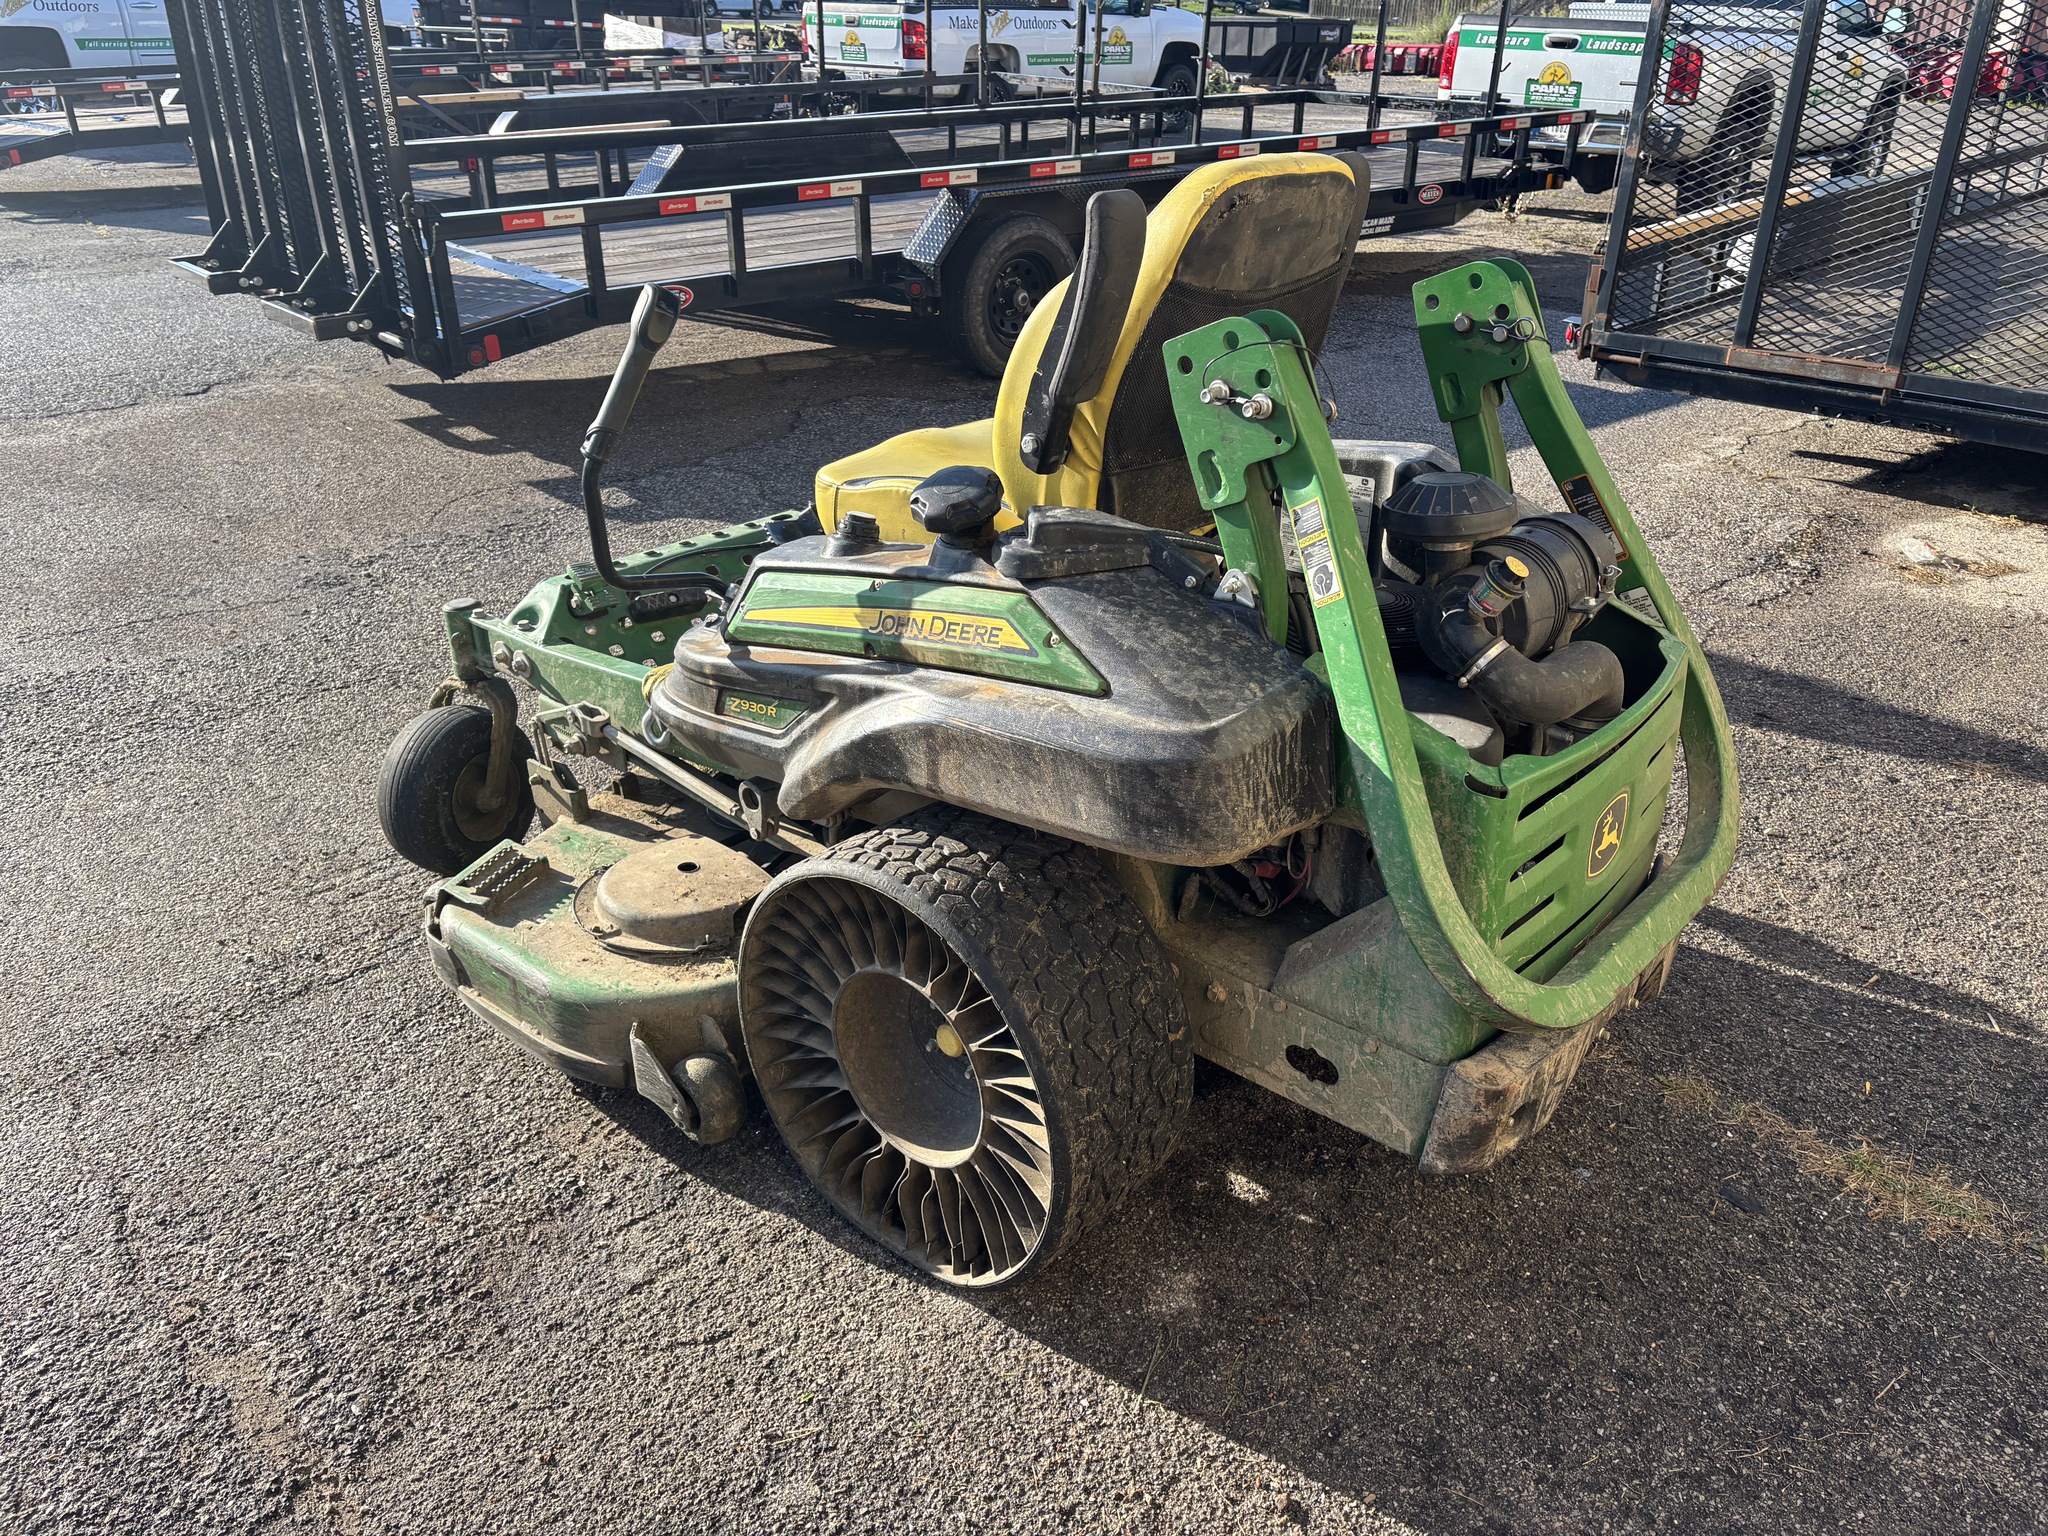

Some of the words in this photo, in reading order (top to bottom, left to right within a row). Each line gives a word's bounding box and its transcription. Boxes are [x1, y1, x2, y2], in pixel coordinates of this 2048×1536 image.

[33, 0, 100, 13] Outdoors
[862, 17, 898, 28] Landscaping
[949, 15, 979, 30] Make
[1014, 16, 1057, 30] Outdoors
[1475, 32, 1531, 47] Lawcare
[1586, 37, 1645, 54] Landscap
[1529, 84, 1578, 95] PAHL'S
[1378, 215, 1396, 226] MADE
[869, 611, 926, 635] JOHN
[928, 615, 1004, 646] DEERE
